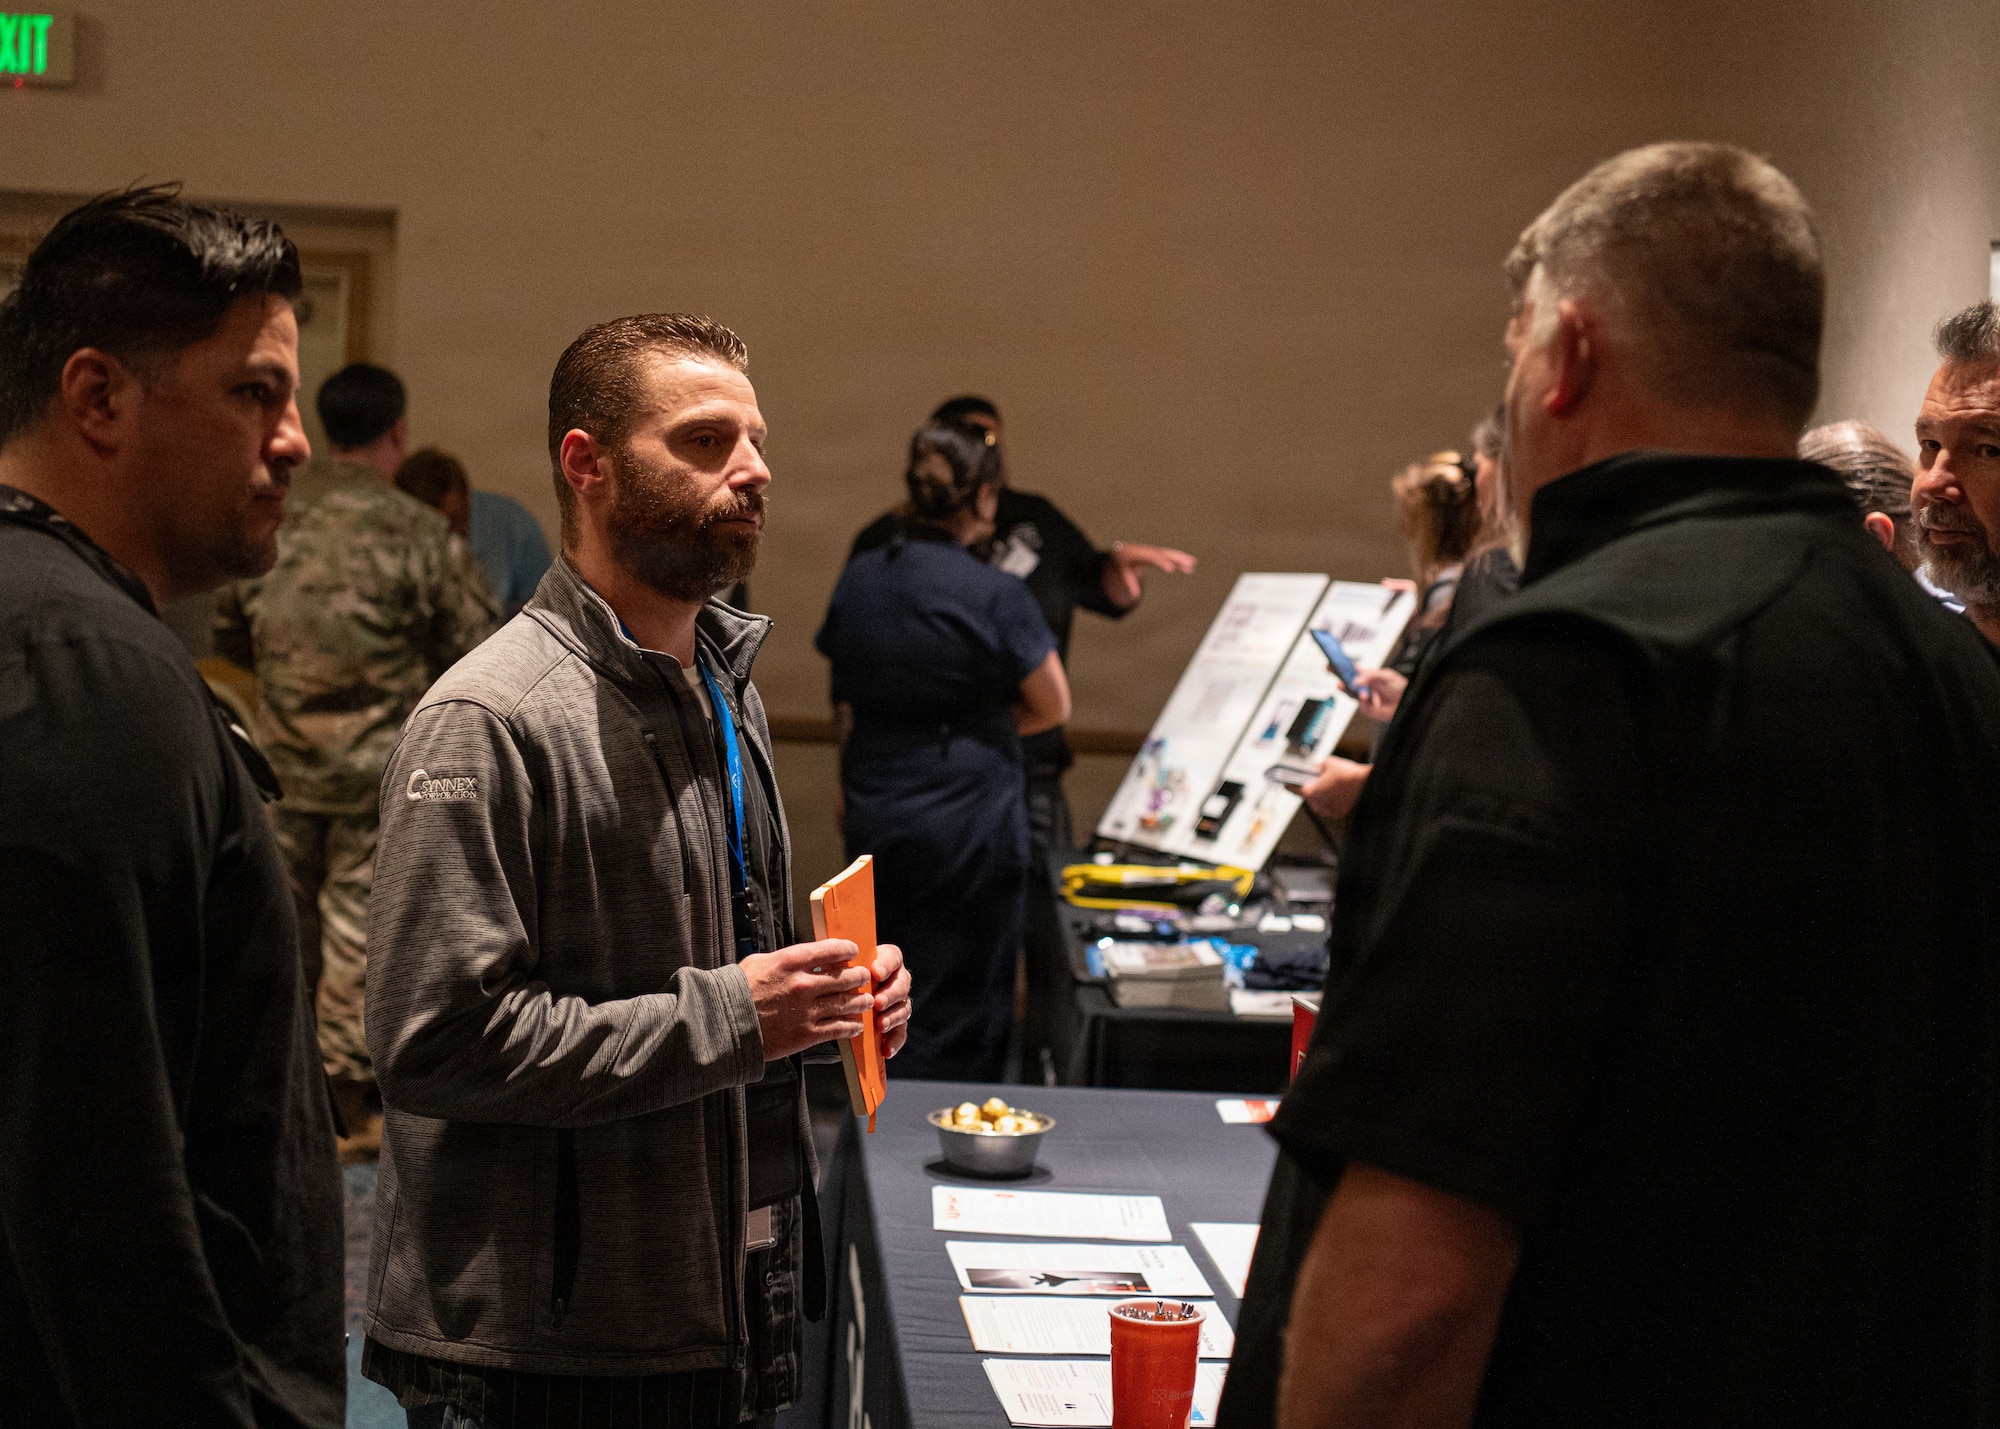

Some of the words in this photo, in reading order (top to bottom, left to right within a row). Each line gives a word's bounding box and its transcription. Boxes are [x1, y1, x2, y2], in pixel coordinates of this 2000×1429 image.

[0, 12, 53, 75] XIT
[422, 777, 475, 793] SYNNEX
[421, 791, 477, 800] CORPORATION
